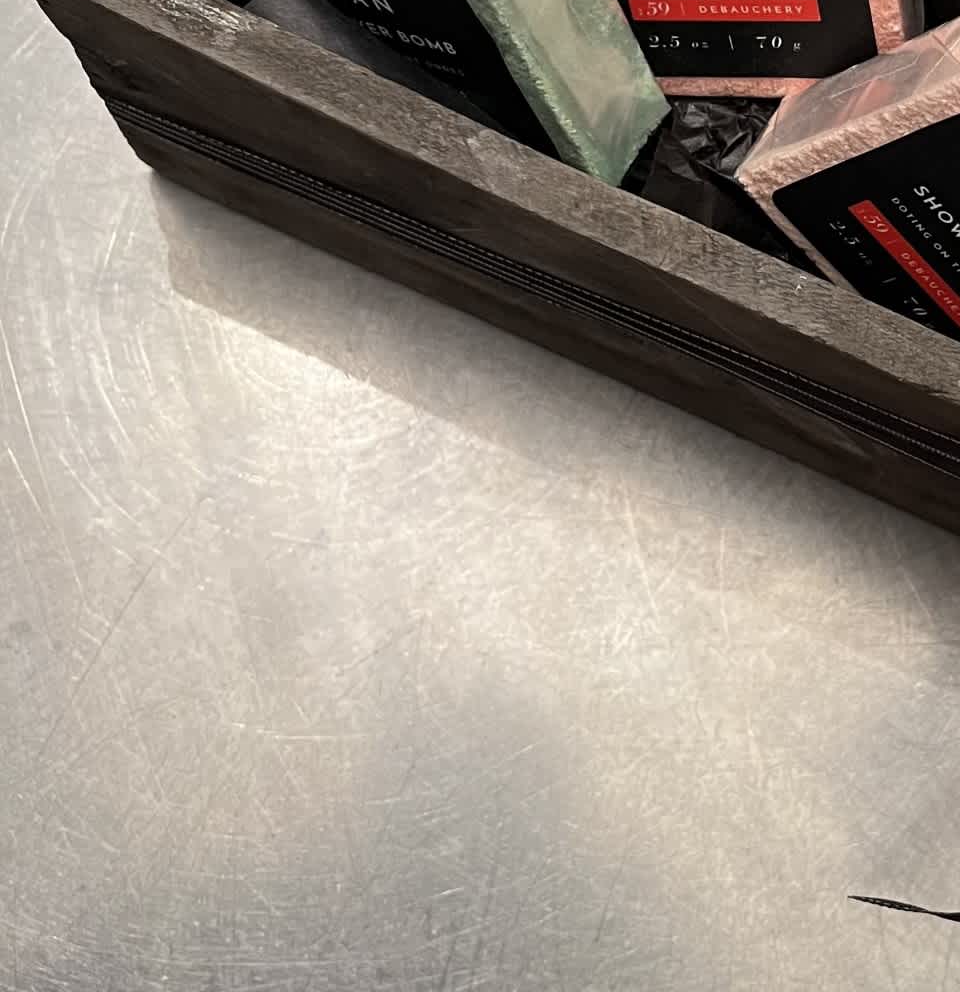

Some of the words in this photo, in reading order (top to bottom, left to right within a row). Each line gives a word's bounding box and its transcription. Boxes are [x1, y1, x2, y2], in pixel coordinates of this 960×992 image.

[699, 5, 803, 14] DEBAUCHERY
[648, 35, 680, 49] 2.5
[756, 35, 783, 49] 70
[891, 197, 932, 239] DOTING
[933, 242, 950, 258] ON
